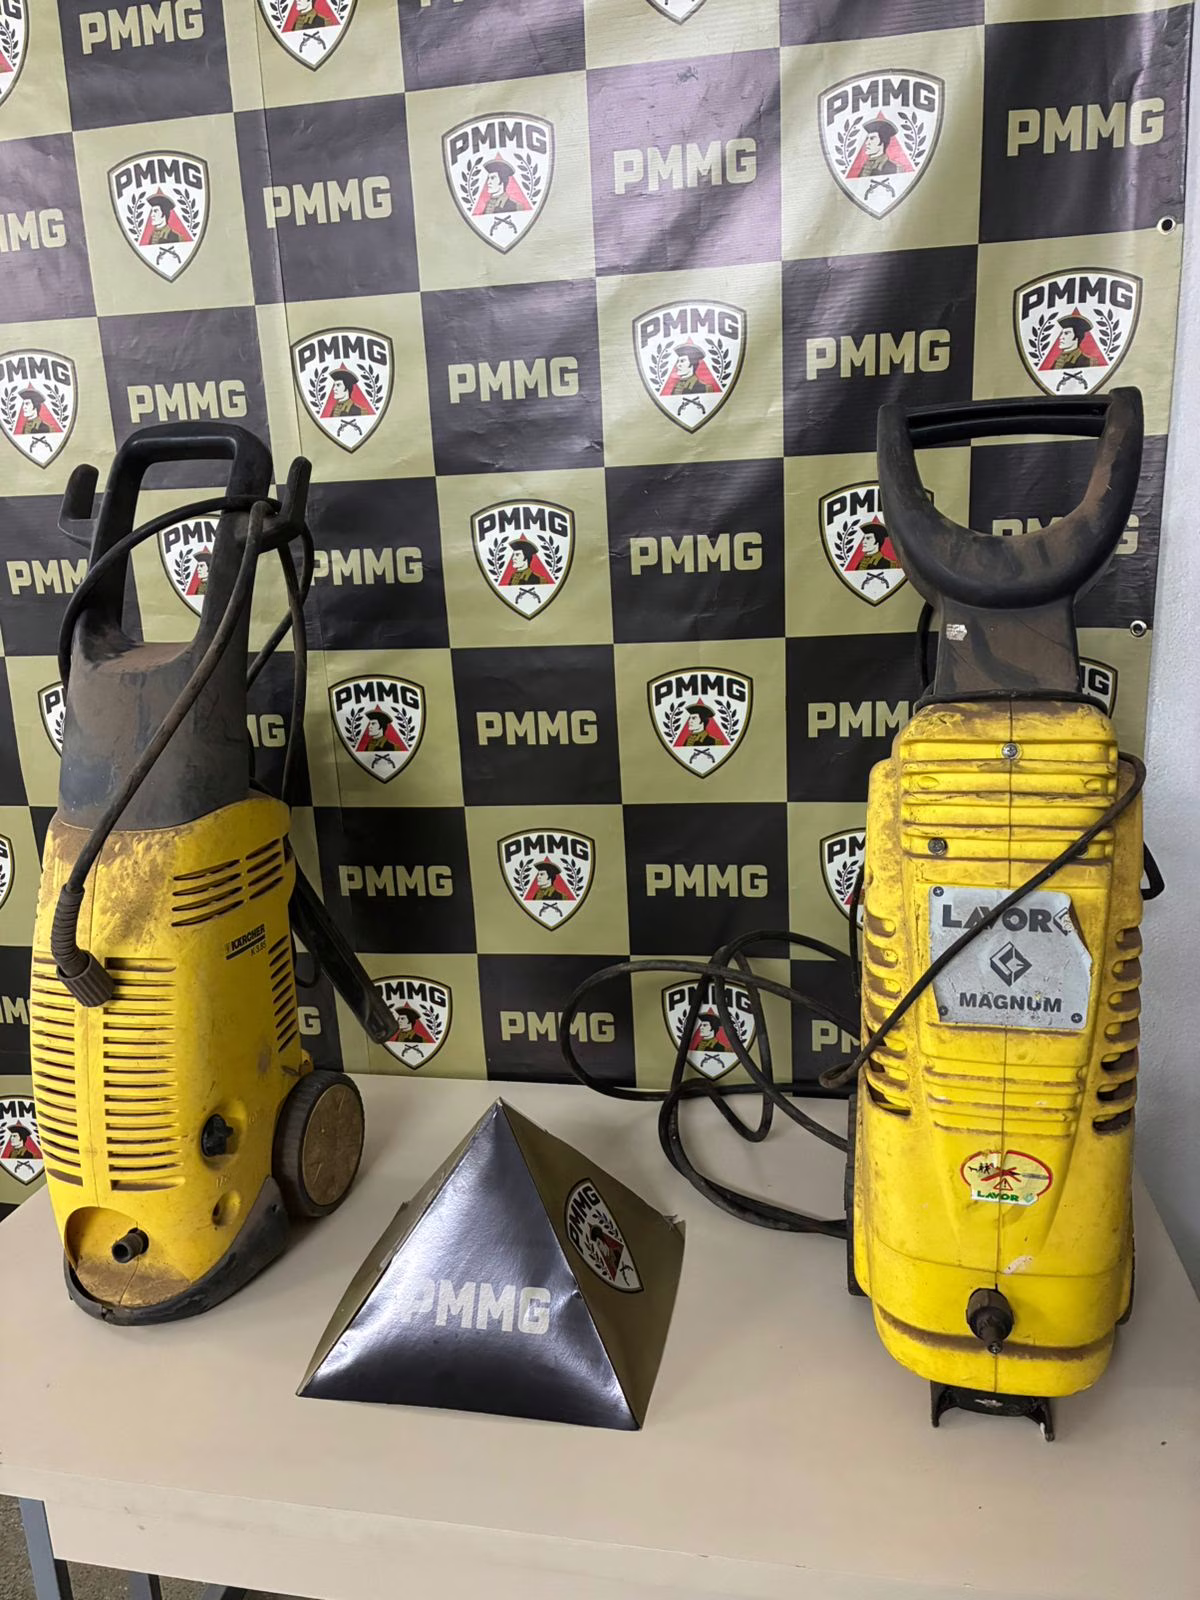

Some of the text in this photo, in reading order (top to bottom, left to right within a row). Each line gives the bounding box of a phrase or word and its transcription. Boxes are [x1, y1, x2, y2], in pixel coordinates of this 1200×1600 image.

[79, 2, 204, 55] PMMG
[826, 79, 936, 127] PMMG
[449, 121, 547, 167] PMMG
[1007, 97, 1165, 157] PMMG
[115, 159, 202, 198] PMMG
[613, 138, 757, 194] PMMG
[263, 176, 392, 229] PMMG
[1021, 276, 1133, 321] PMMG
[640, 308, 739, 349] PMMG
[300, 335, 387, 371] PMMG
[806, 329, 951, 381] PMMG
[448, 357, 579, 404] PMMG
[127, 380, 247, 423] PMMG
[478, 507, 568, 542] PMMG
[827, 488, 883, 526] PM
[630, 532, 763, 575] PMMG
[6, 558, 88, 595] PMM
[334, 681, 420, 712] PMMG
[654, 674, 746, 706] PMMG
[476, 710, 598, 746] PMMG
[808, 700, 916, 738] PMM
[504, 834, 589, 863] PMMG
[338, 865, 453, 897] PMMG
[645, 864, 768, 898] PMMG
[376, 981, 447, 1008] MMG
[959, 992, 1062, 1013] MAGNUM
[500, 1011, 615, 1042] PMMG
[977, 1190, 1019, 1202] LAVOR
[568, 1185, 600, 1248] PMMG
[398, 1278, 551, 1335] PMMG
